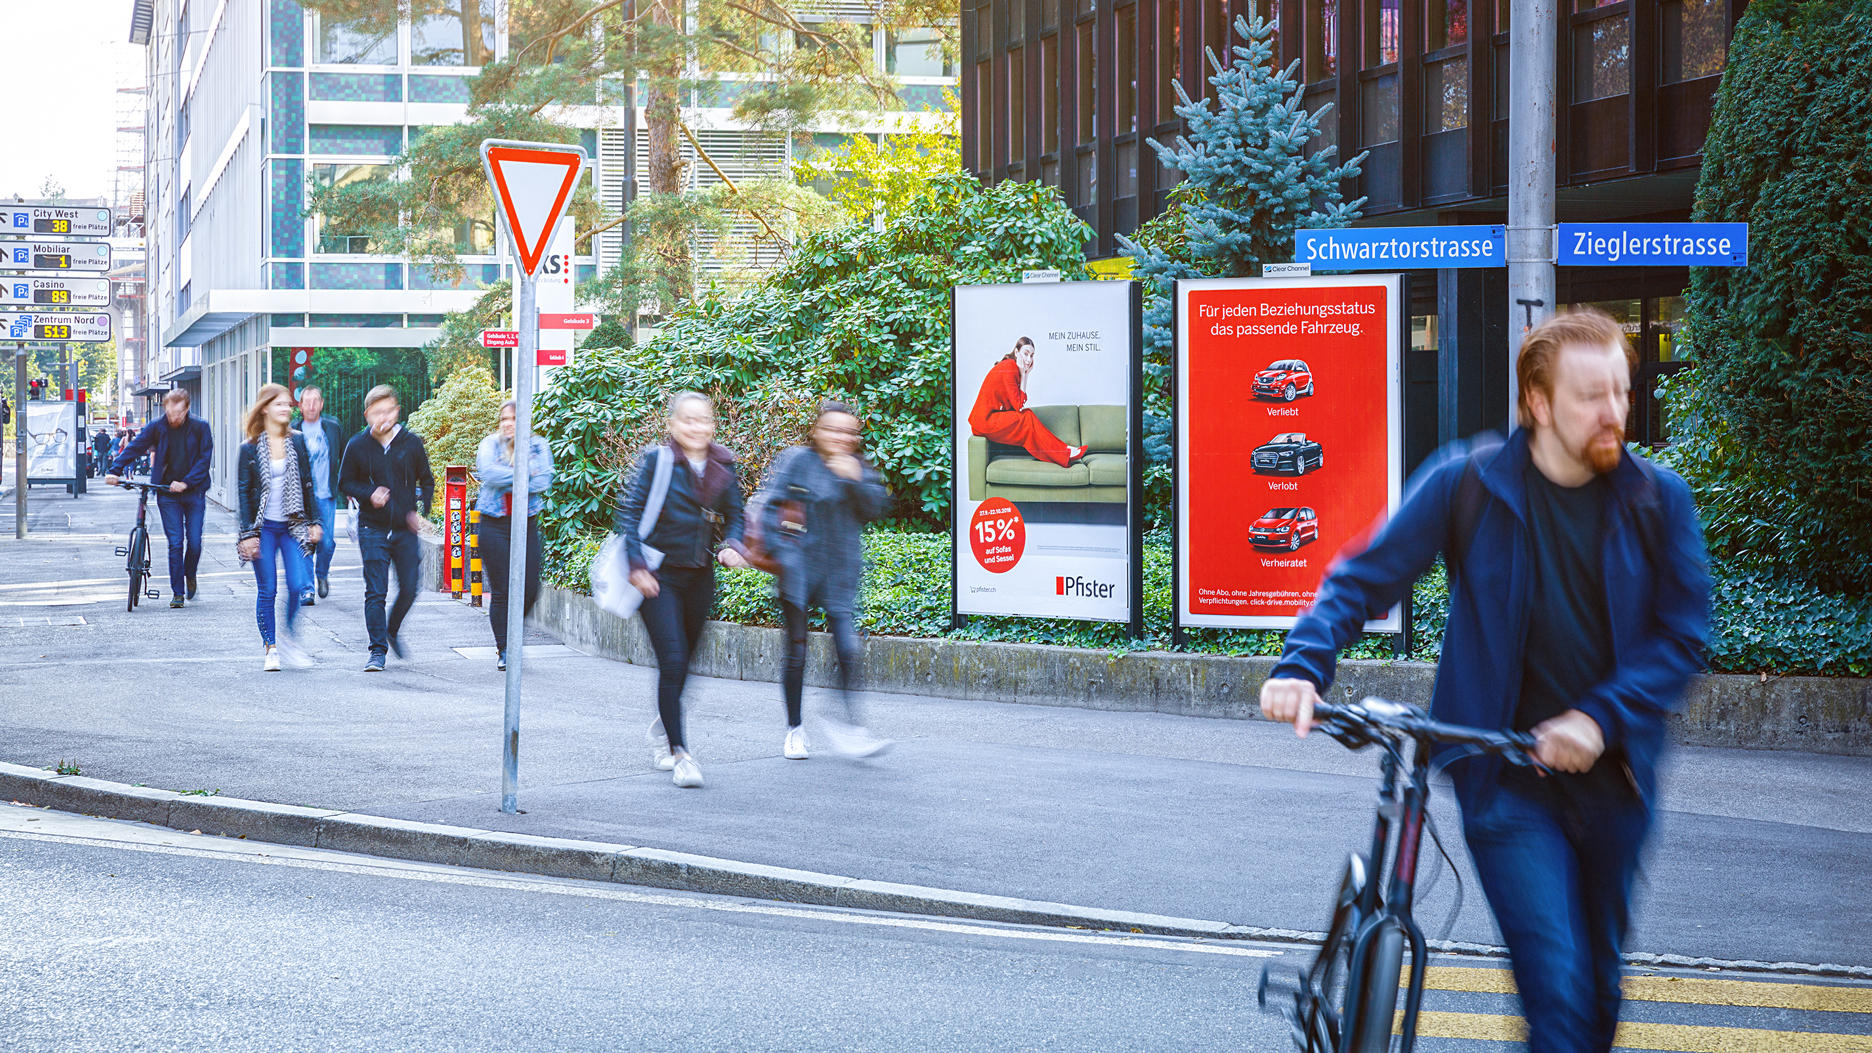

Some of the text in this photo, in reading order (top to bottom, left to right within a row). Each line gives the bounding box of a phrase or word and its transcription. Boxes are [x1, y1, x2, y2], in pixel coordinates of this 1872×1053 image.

[33, 209, 79, 219] City West
[52, 219, 68, 232] 38
[33, 244, 71, 253] Mobiliar
[1306, 236, 1494, 260] Schwarztorstrasse
[1573, 230, 1731, 262] Zieglerstrasse
[59, 255, 68, 268] 1
[33, 280, 65, 288] Casino
[51, 290, 68, 303] 89
[1199, 301, 1376, 320] Für jeden Beziehungsstatus
[33, 315, 95, 324] Zentrum Nord
[44, 325, 68, 338] 513
[1210, 320, 1364, 338] das passende Fahrzeug.
[1048, 330, 1101, 340] MEIN ZUHAUSE.
[1066, 343, 1101, 352] MEIN STIL.
[1266, 406, 1299, 417] Verliebt
[1267, 481, 1299, 491] Verlobt
[985, 545, 1012, 555] auf Sofas
[984, 553, 1015, 564] und Sessel
[1260, 557, 1308, 568] Verheiratet
[1065, 575, 1116, 598] Pfister
[1198, 588, 1216, 596] Ohne
[1231, 589, 1247, 597] ohne
[1301, 590, 1319, 598] ohne
